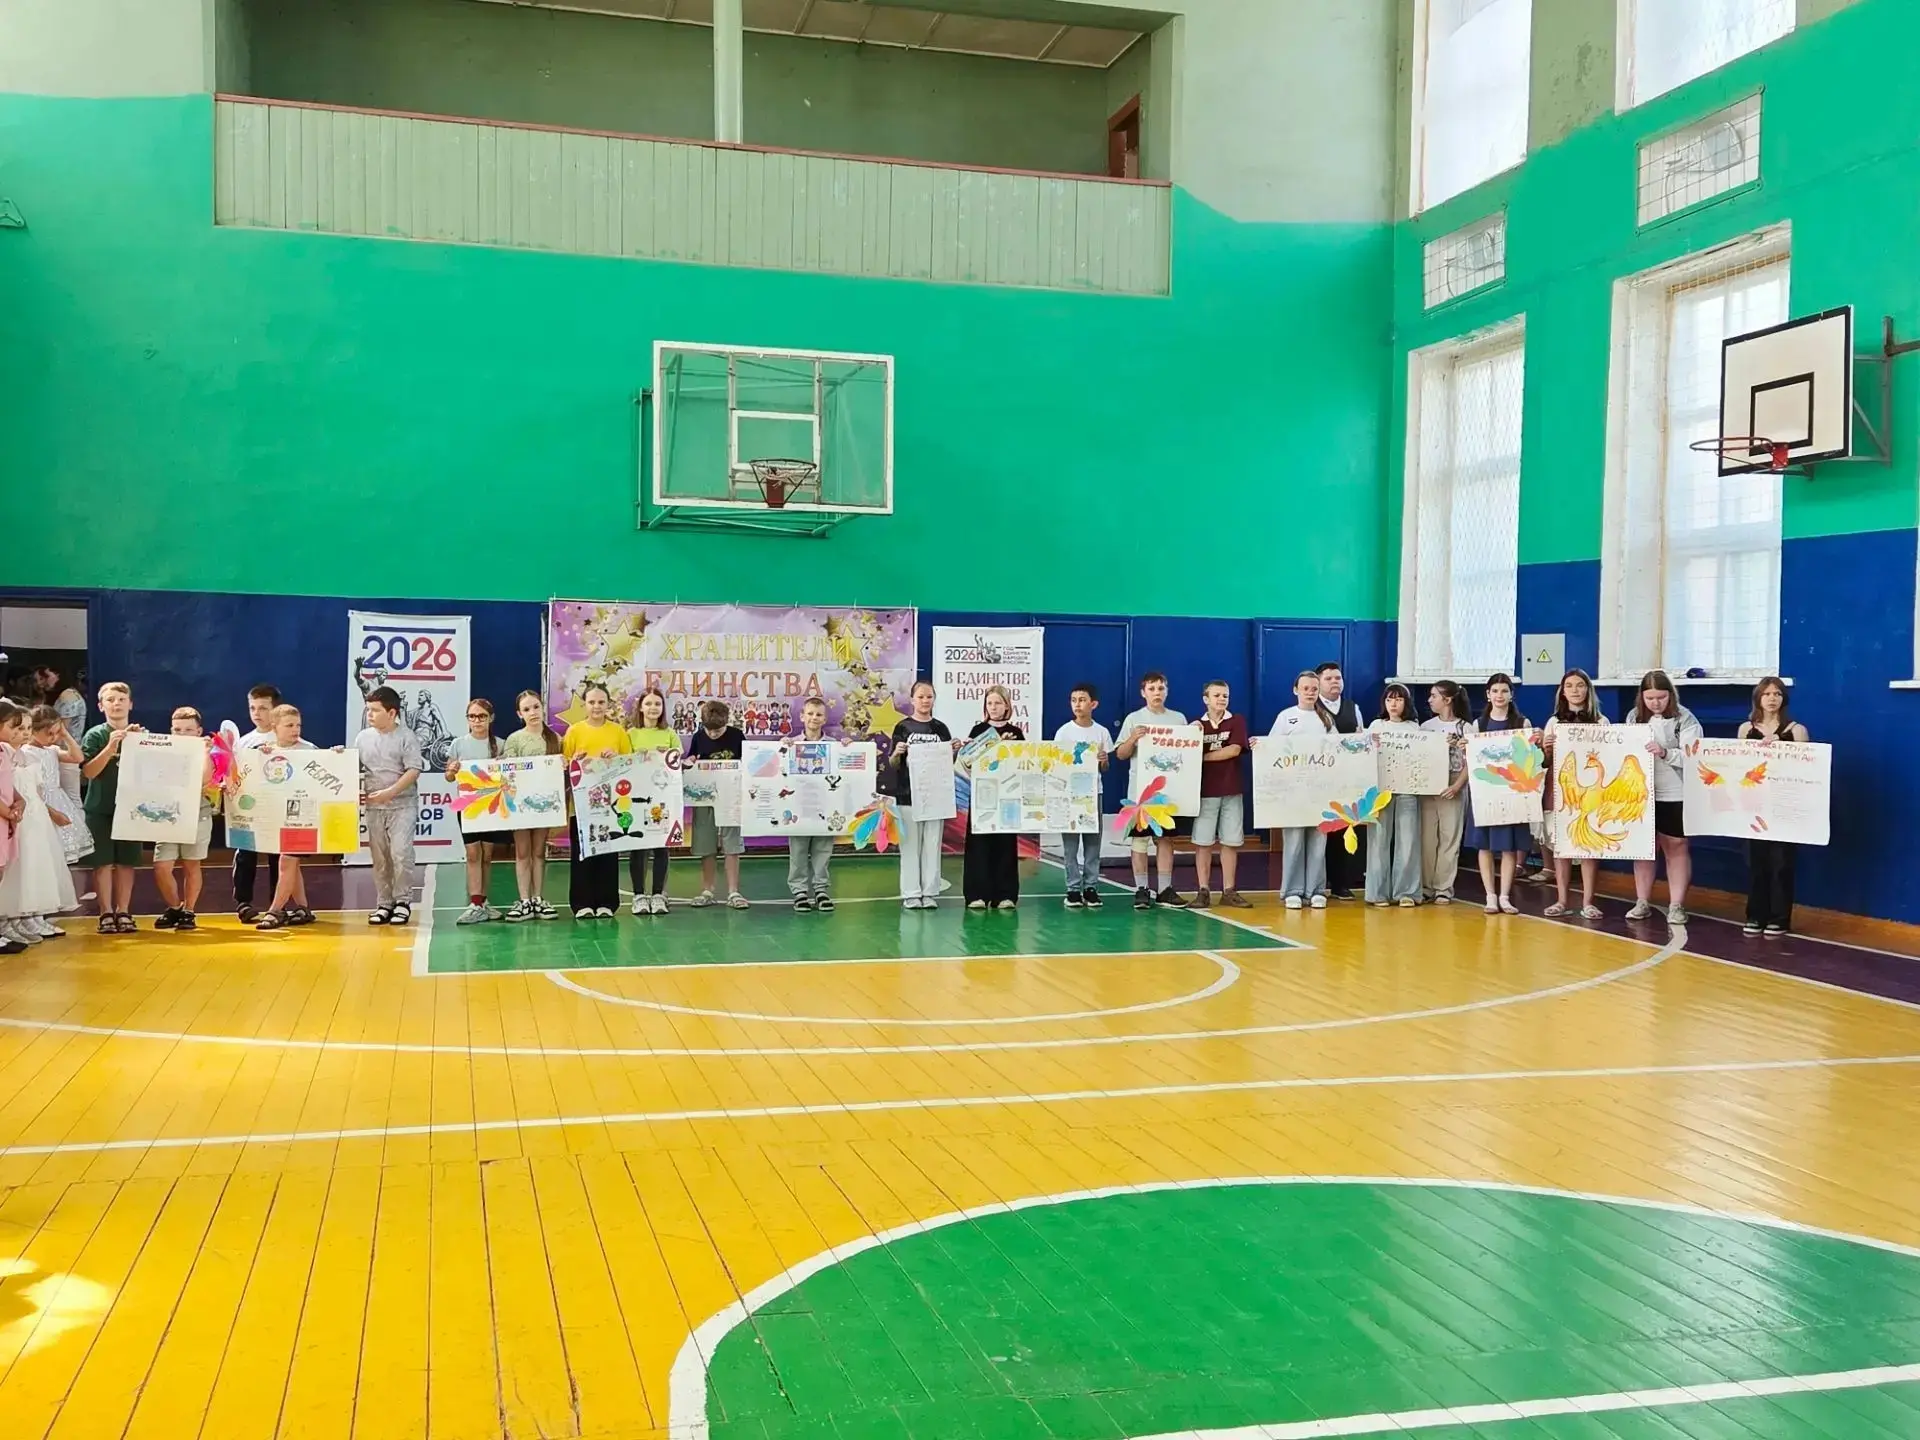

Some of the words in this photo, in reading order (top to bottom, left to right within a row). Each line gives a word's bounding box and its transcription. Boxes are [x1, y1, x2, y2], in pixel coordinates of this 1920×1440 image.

[362, 635, 457, 671] 2026
[660, 633, 850, 662] ХРАНИТЕЛИ
[945, 648, 977, 661] 2026
[645, 670, 824, 699] ЕДИНСТВА
[944, 672, 954, 684] В
[957, 671, 1030, 686] ЕДИНСТВЕ
[956, 687, 1021, 701] НАРВ
[303, 760, 344, 796] РЕБЯТА
